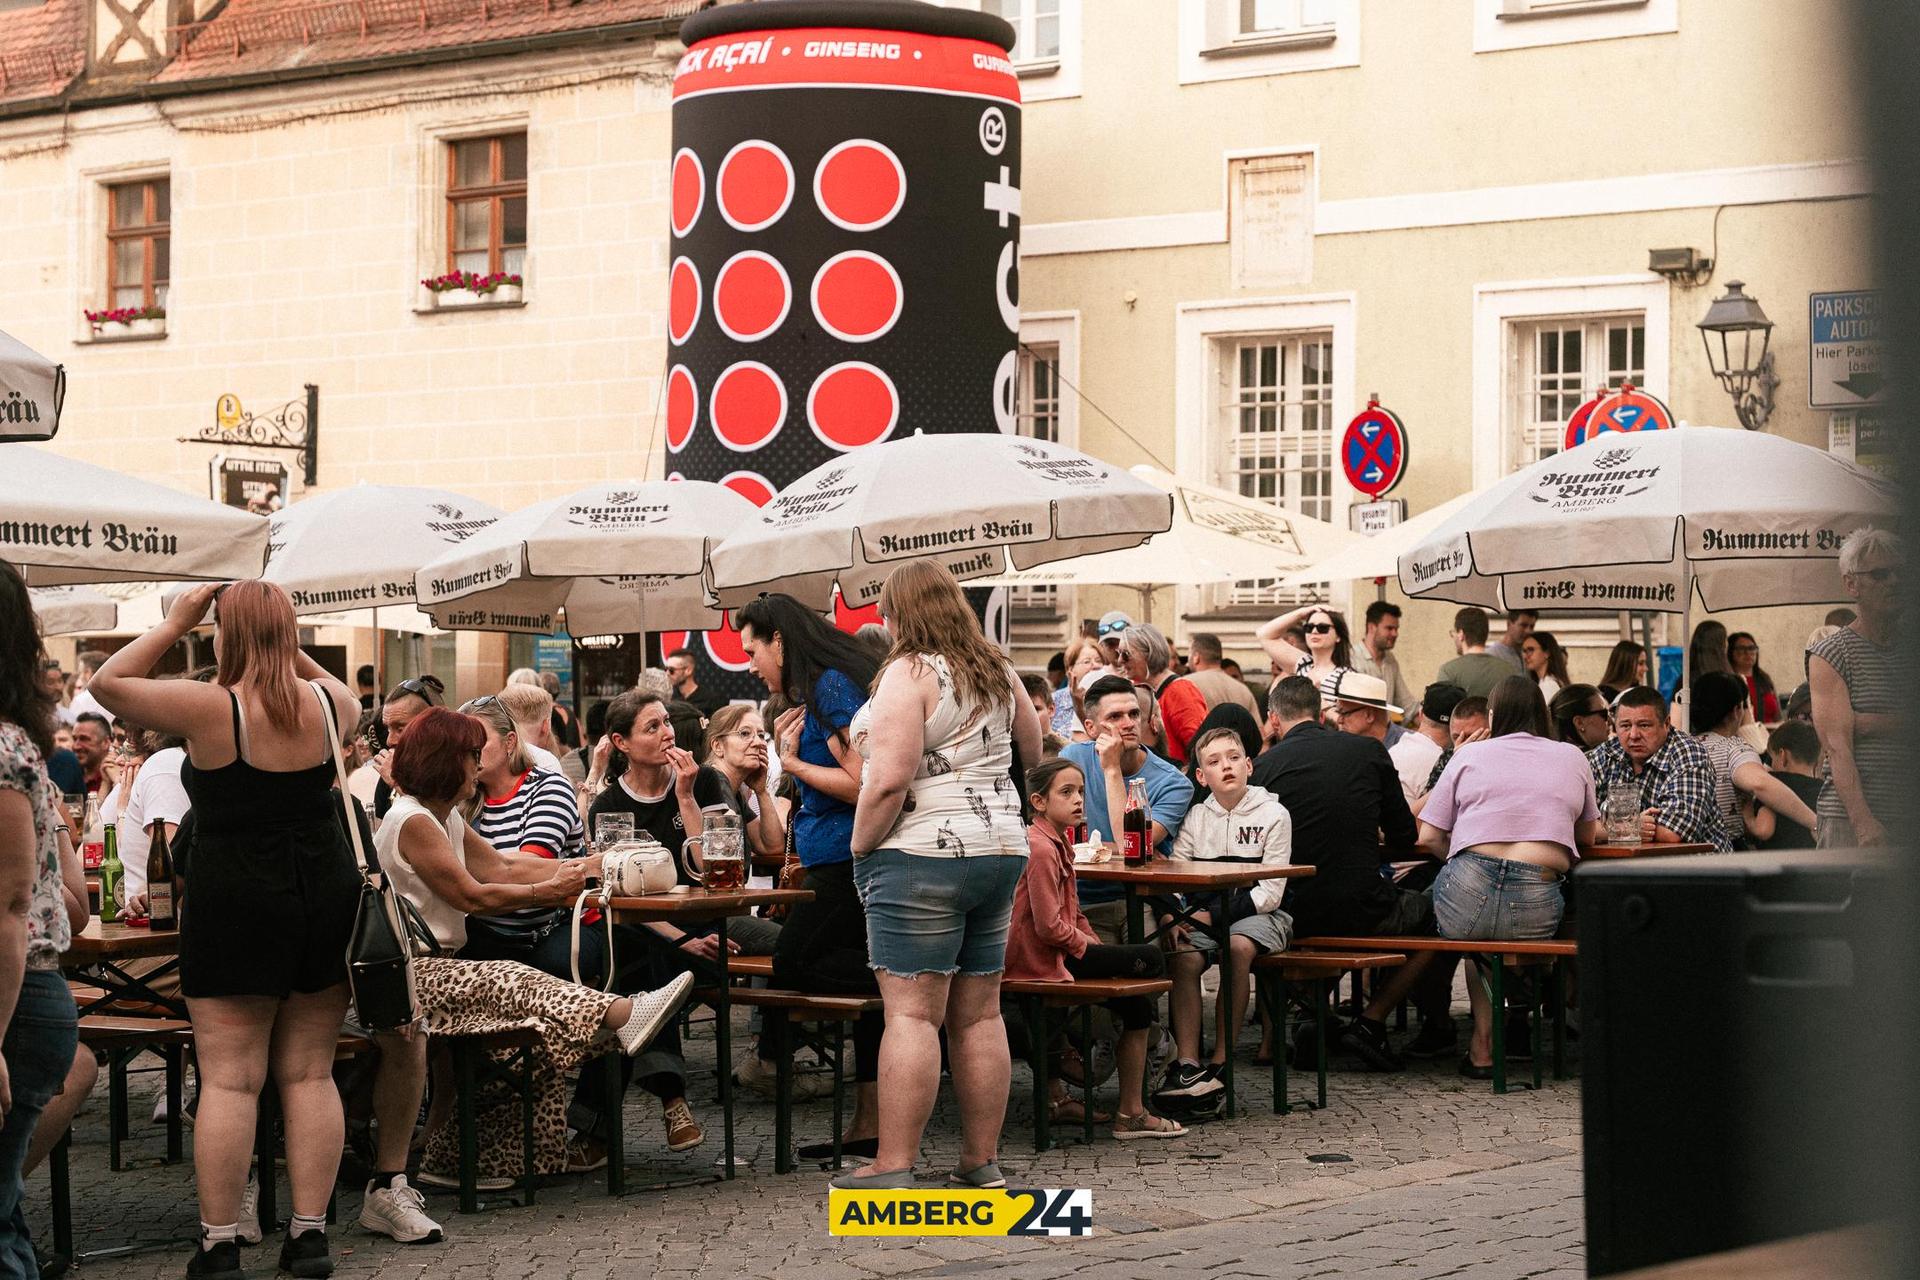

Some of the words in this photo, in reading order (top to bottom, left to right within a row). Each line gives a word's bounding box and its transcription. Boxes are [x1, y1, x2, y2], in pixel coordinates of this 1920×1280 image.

[707, 36, 775, 73] AÇAÍ
[804, 41, 901, 60] GINSENG
[1816, 347, 1842, 359] Hier
[0, 391, 40, 423] räu
[1557, 482, 1625, 499] Bräu
[1551, 497, 1618, 508] AMBERG
[982, 519, 1034, 540] Bräu
[1816, 527, 1852, 551] Br
[102, 523, 178, 556] Bräu
[381, 581, 415, 598] Brä
[1237, 826, 1265, 845] NY
